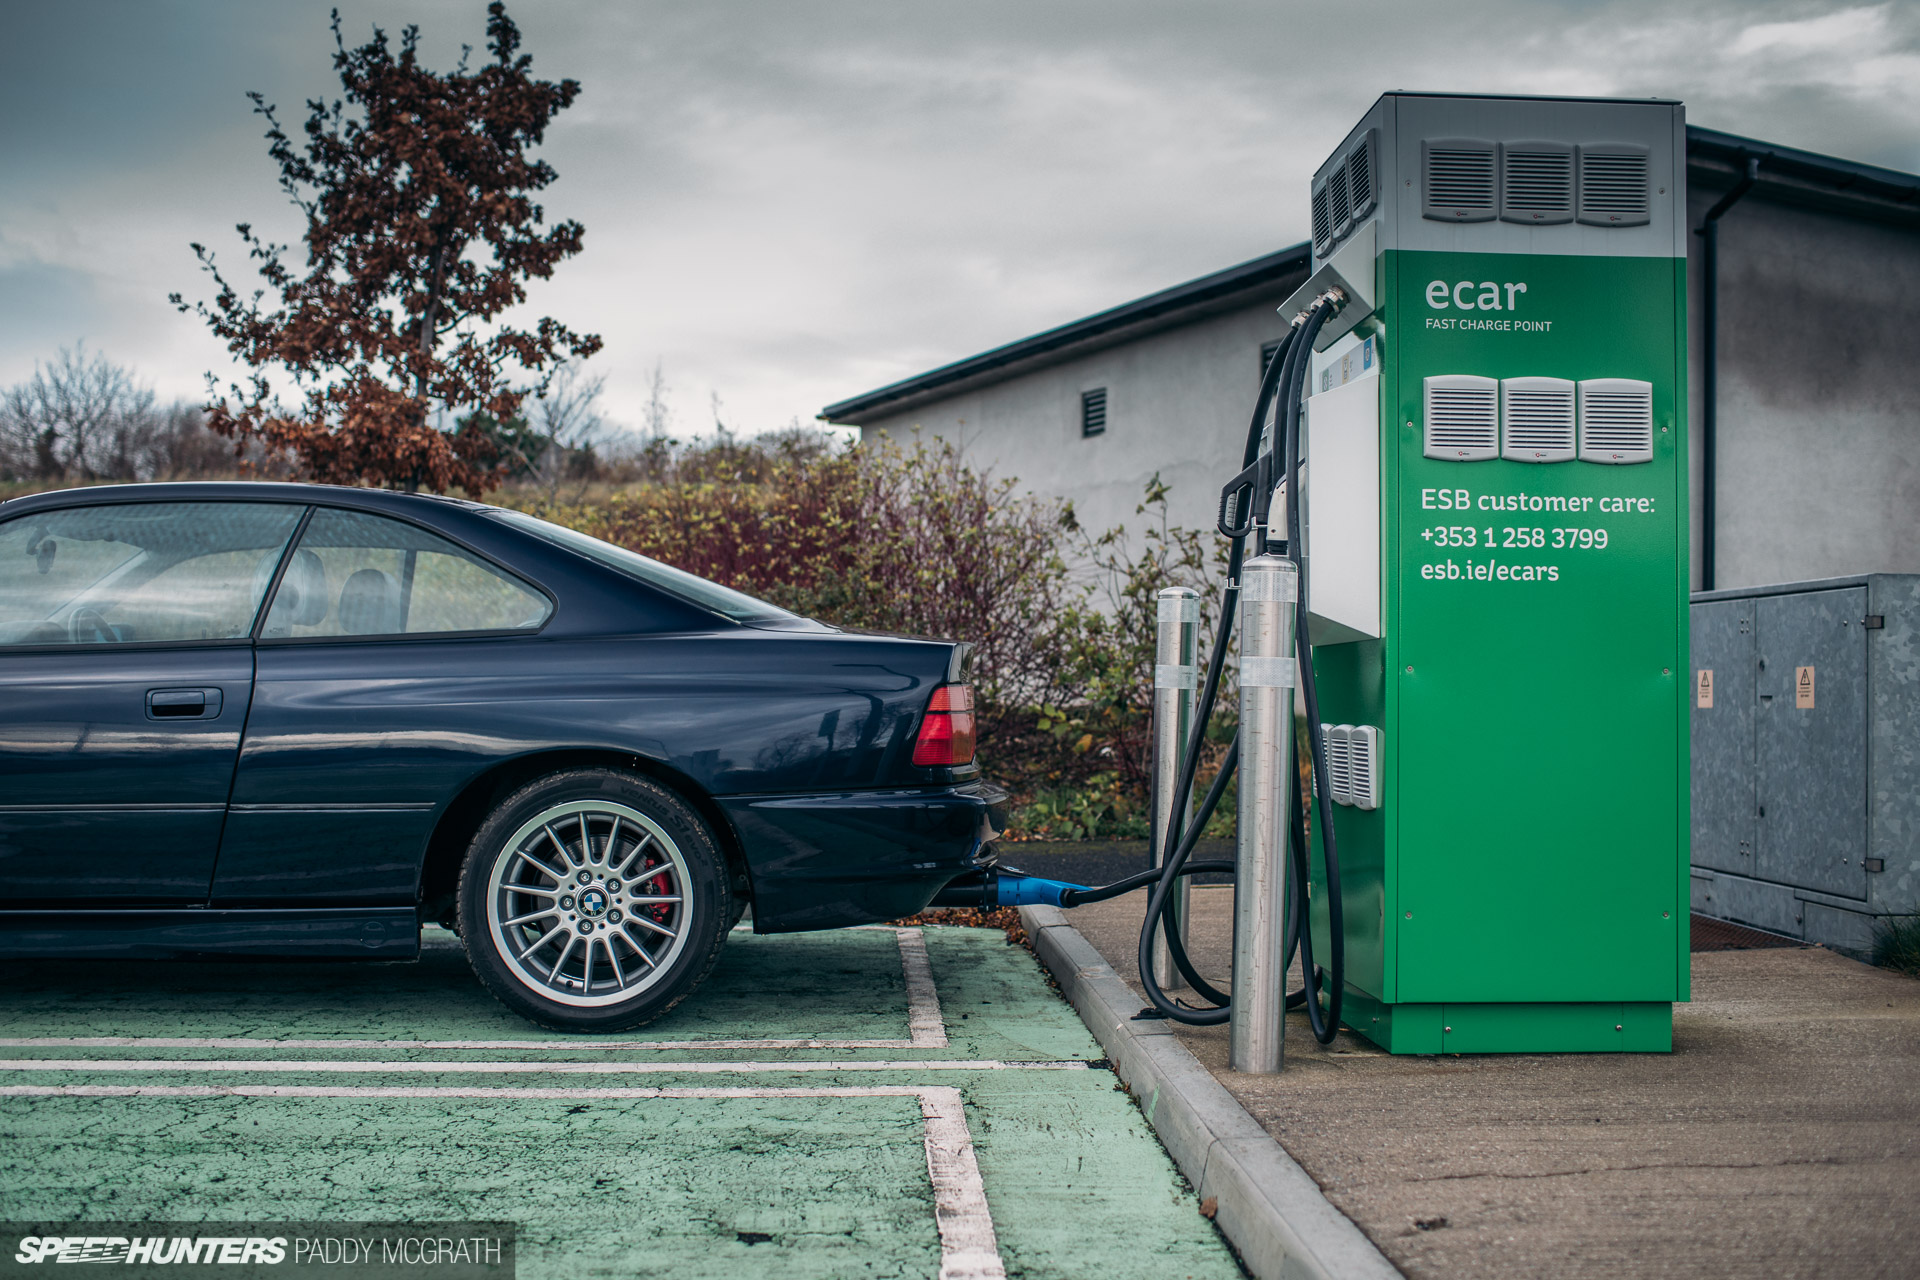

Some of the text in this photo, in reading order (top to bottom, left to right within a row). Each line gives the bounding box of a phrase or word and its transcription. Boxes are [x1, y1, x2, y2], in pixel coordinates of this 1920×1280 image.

[1425, 279, 1528, 311] ecar
[1425, 318, 1553, 332] FAST CHARGE POINT
[1421, 488, 1656, 513] ESB customer care:
[1420, 525, 1609, 549] +353 1 258 3799
[1420, 558, 1560, 582] esb.ie/ecars
